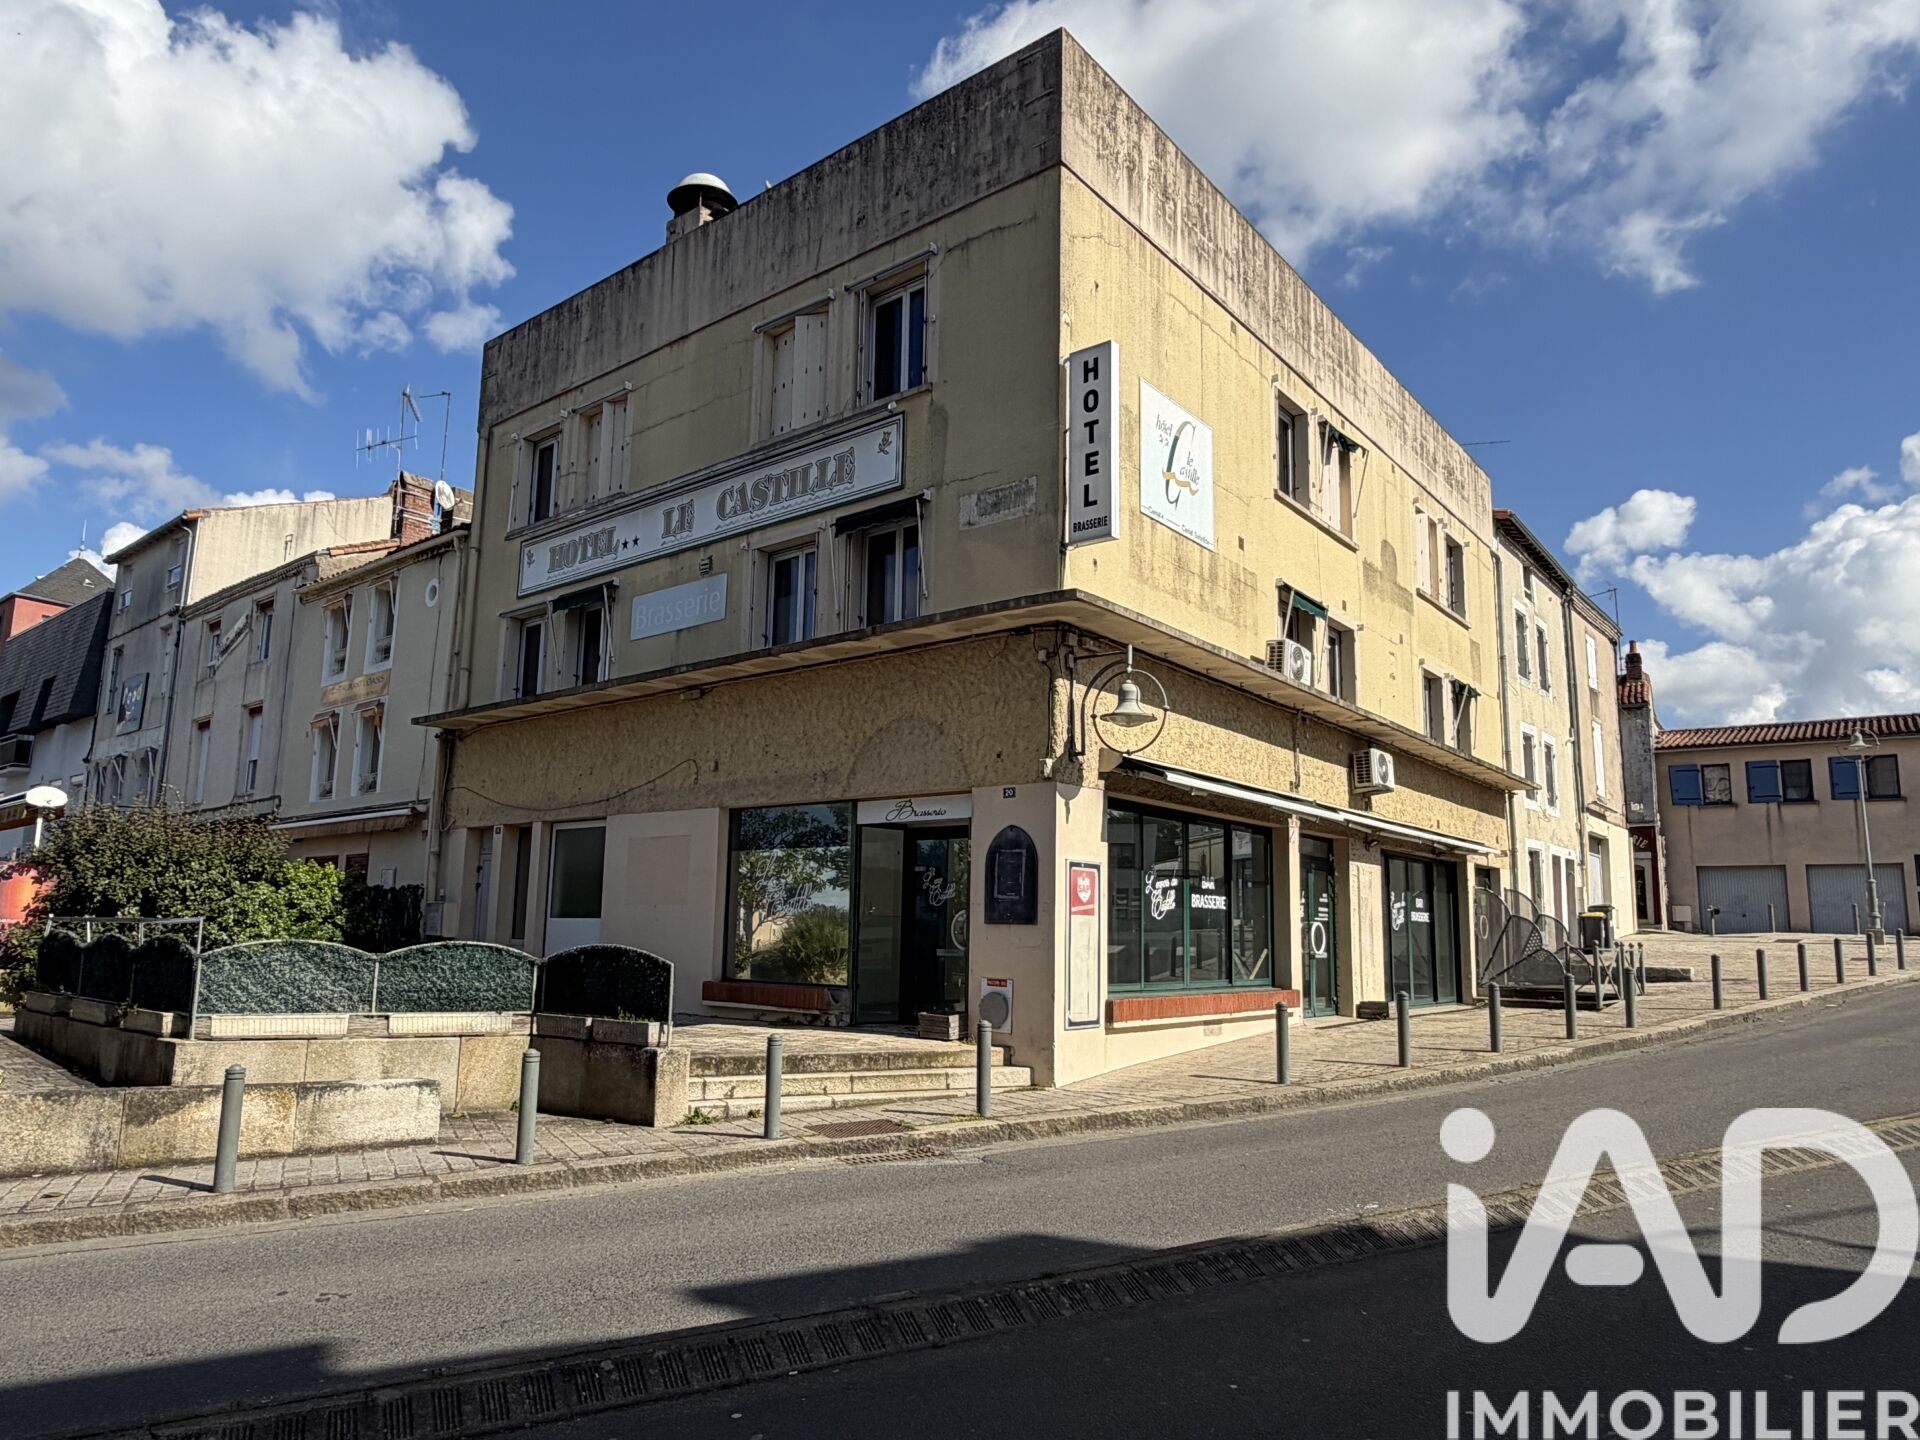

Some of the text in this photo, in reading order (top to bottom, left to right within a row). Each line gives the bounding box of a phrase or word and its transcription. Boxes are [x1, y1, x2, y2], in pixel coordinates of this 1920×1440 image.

[1083, 357, 1100, 507] HOTEL
[547, 446, 857, 574] HOTEL LE CASTILLE
[1072, 516, 1108, 533] BRASSERIE
[635, 586, 721, 630] Brasserie
[885, 798, 947, 822] Brasserie
[1202, 876, 1215, 889] BAR
[1191, 894, 1226, 909] BRASSERIE
